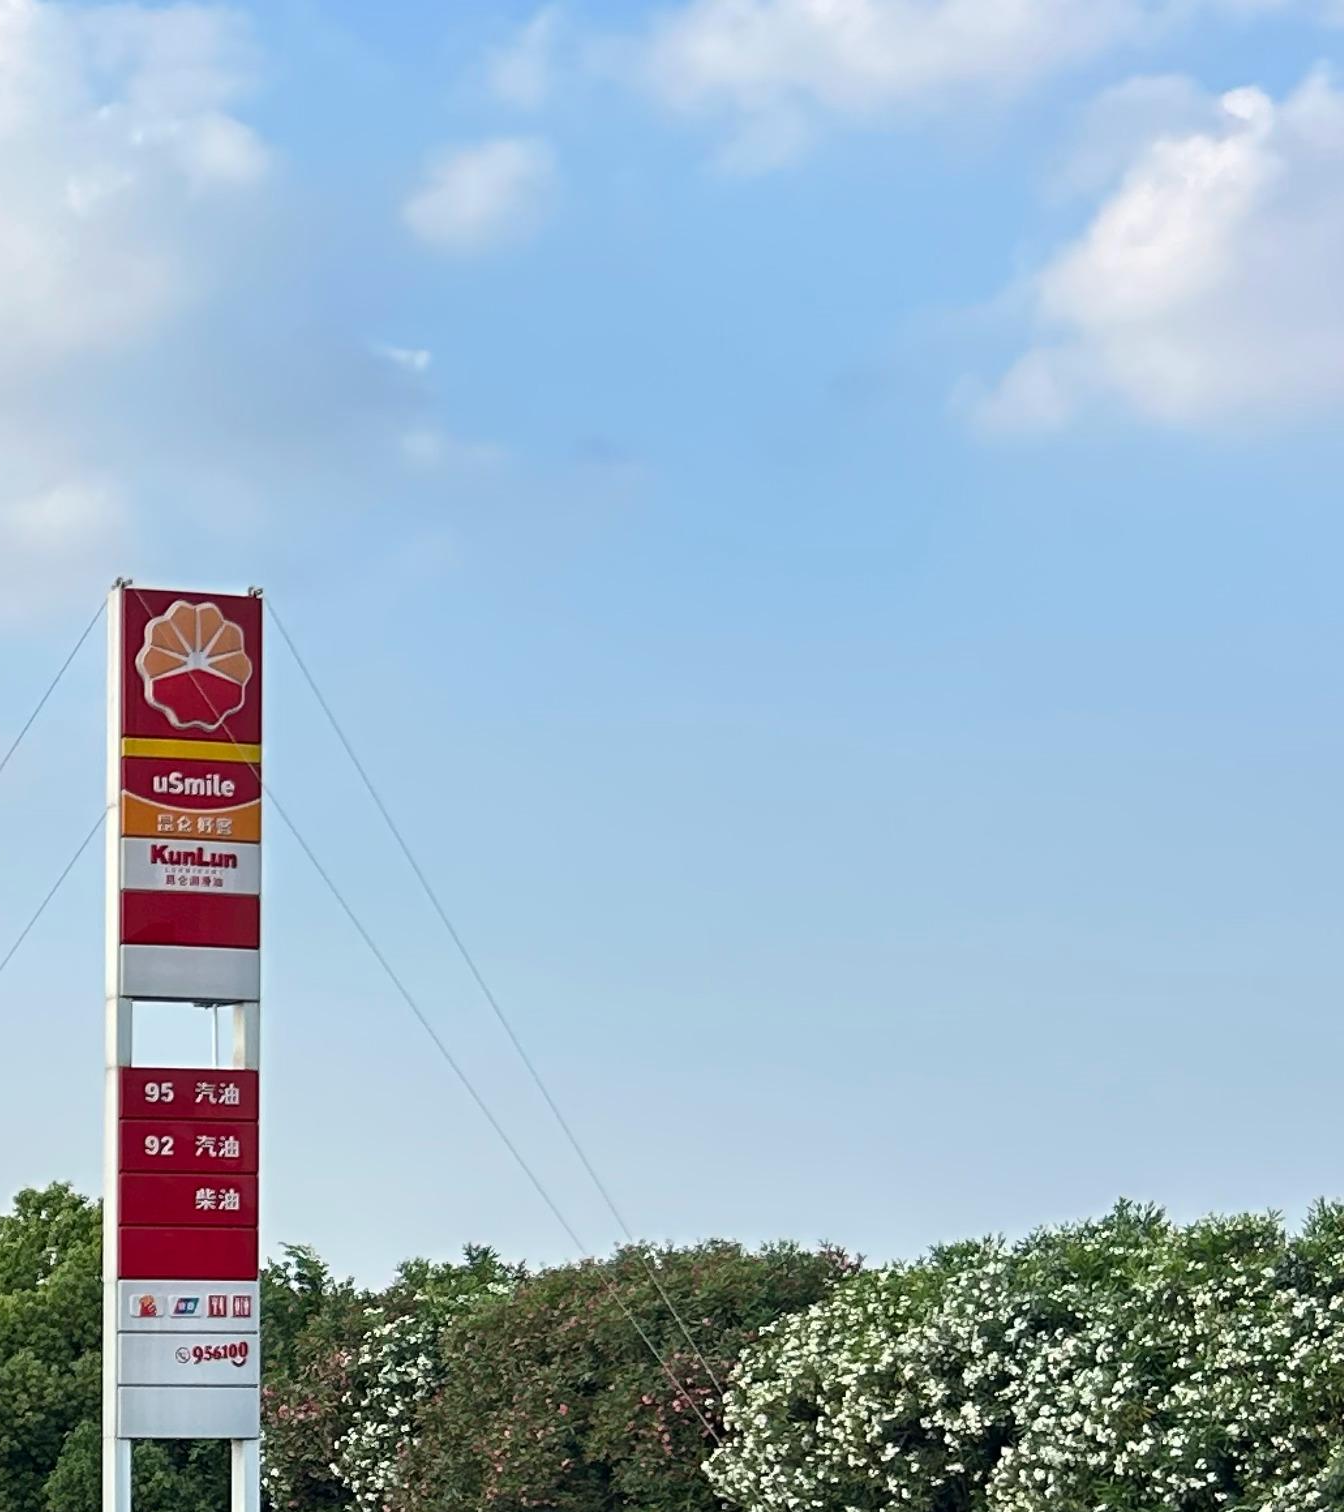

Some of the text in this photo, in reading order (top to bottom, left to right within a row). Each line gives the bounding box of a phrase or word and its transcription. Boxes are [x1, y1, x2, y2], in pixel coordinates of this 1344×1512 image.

[152, 771, 235, 797] uSmile
[157, 814, 232, 835] 昆仑好客
[150, 844, 237, 869] KunLun
[144, 1082, 240, 1105] 95 汽油
[144, 1135, 240, 1158] 92 汽油
[194, 1188, 240, 1211] 柴油
[192, 1341, 249, 1365] 956100
